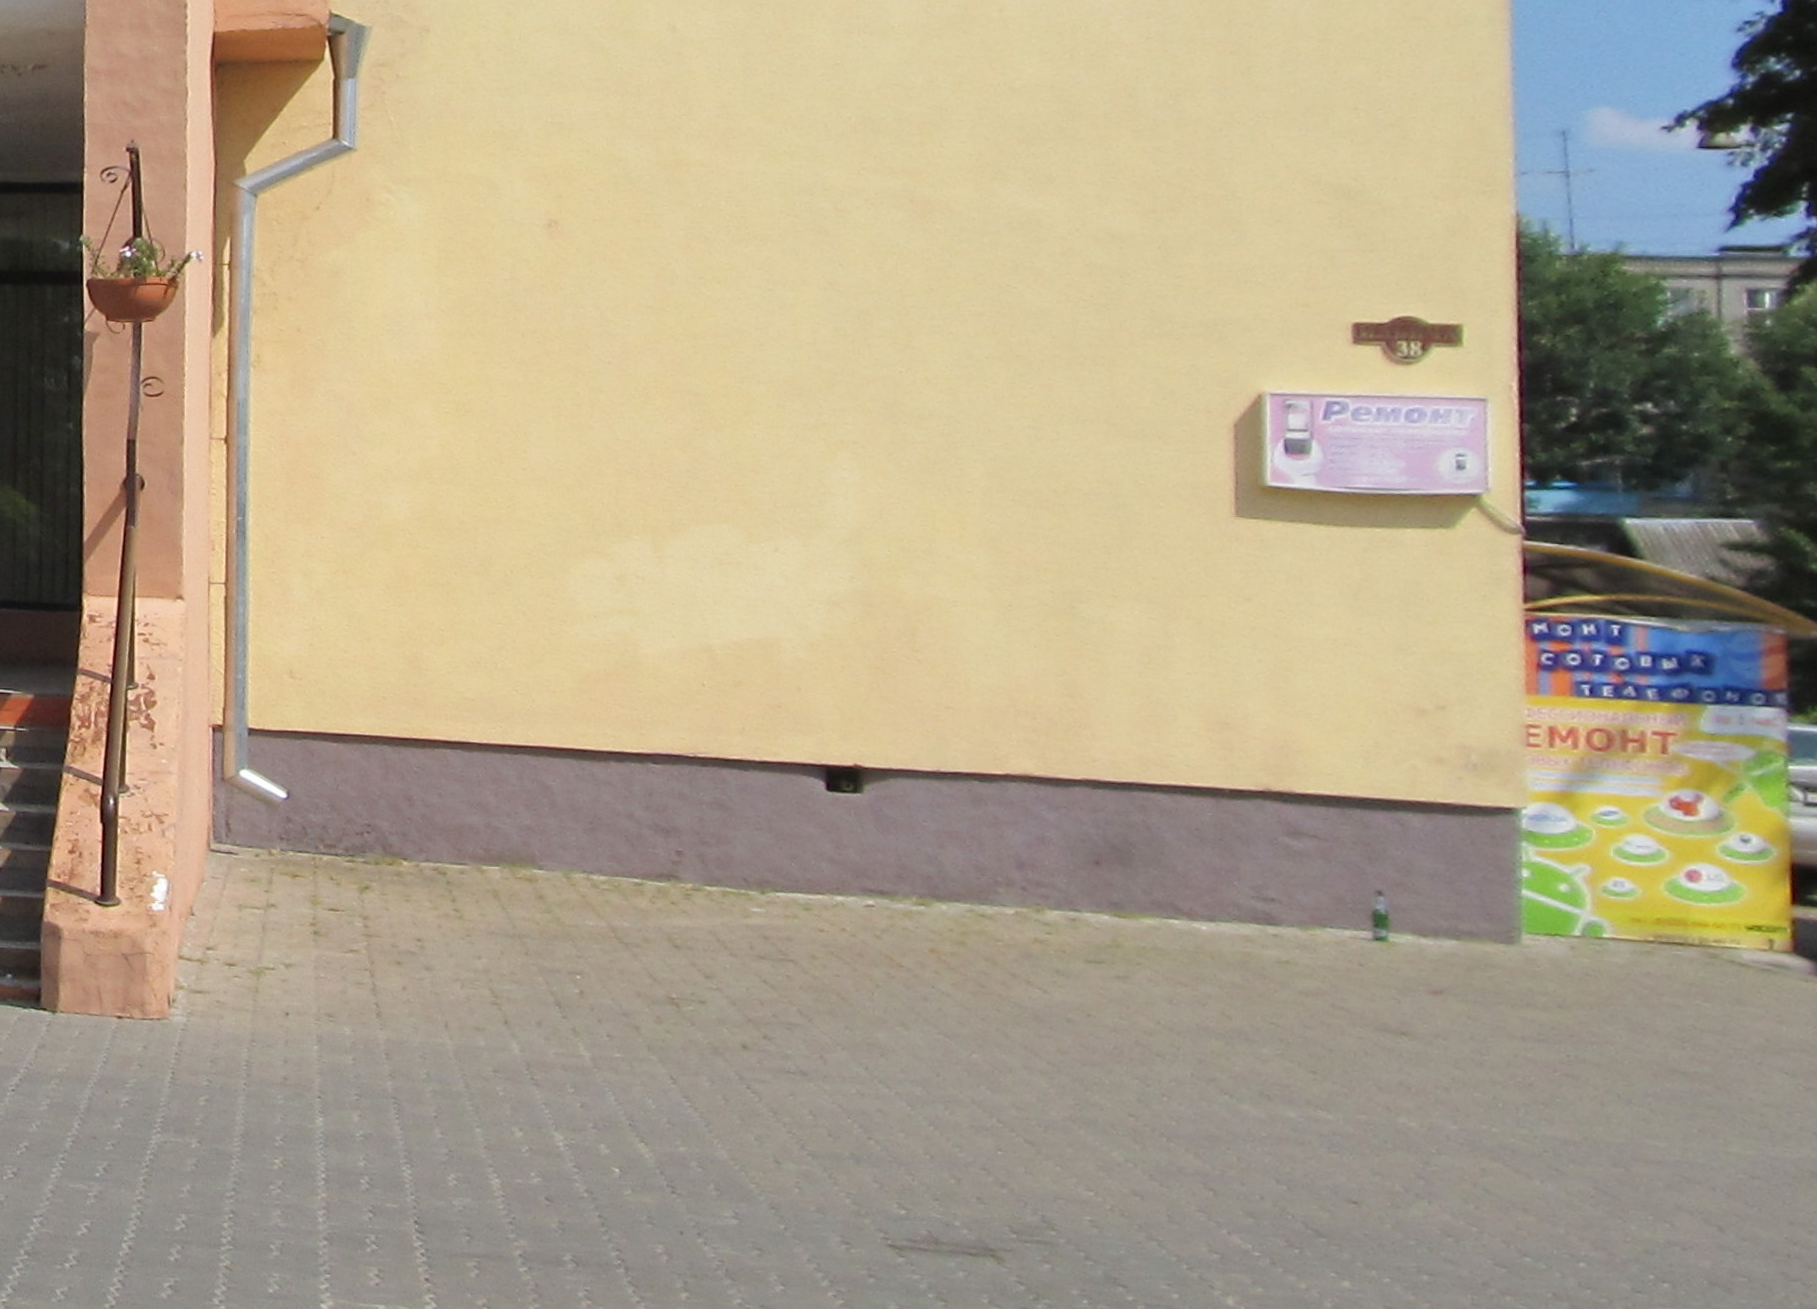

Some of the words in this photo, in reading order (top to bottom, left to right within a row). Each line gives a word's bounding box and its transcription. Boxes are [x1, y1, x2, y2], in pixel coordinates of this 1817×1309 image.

[1396, 340, 1423, 357] 38
[1321, 400, 1475, 425] Ремонт
[1540, 651, 1706, 671] СОТОВЫХ
